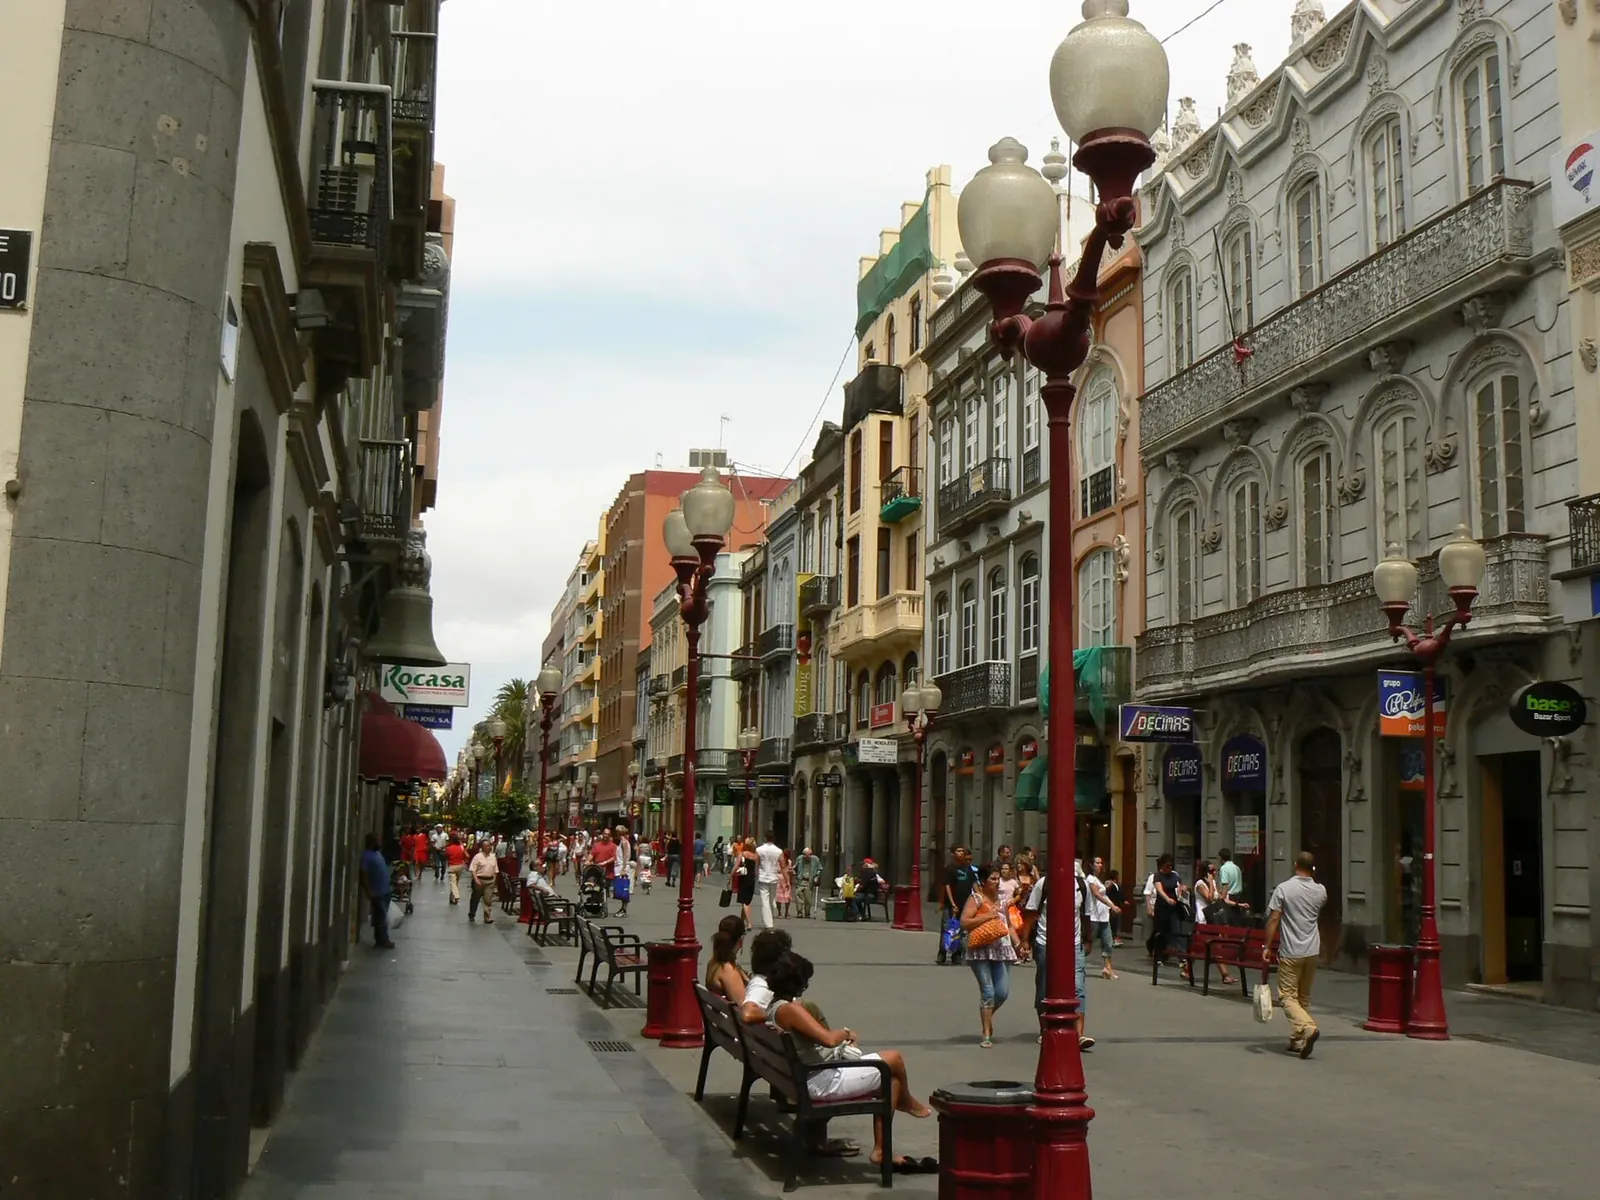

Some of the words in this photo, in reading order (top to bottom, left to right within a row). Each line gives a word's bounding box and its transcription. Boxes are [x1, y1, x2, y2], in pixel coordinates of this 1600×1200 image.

[384, 664, 465, 699] Rocasa
[1533, 712, 1553, 720] Bazar
[1554, 713, 1571, 721] Sport
